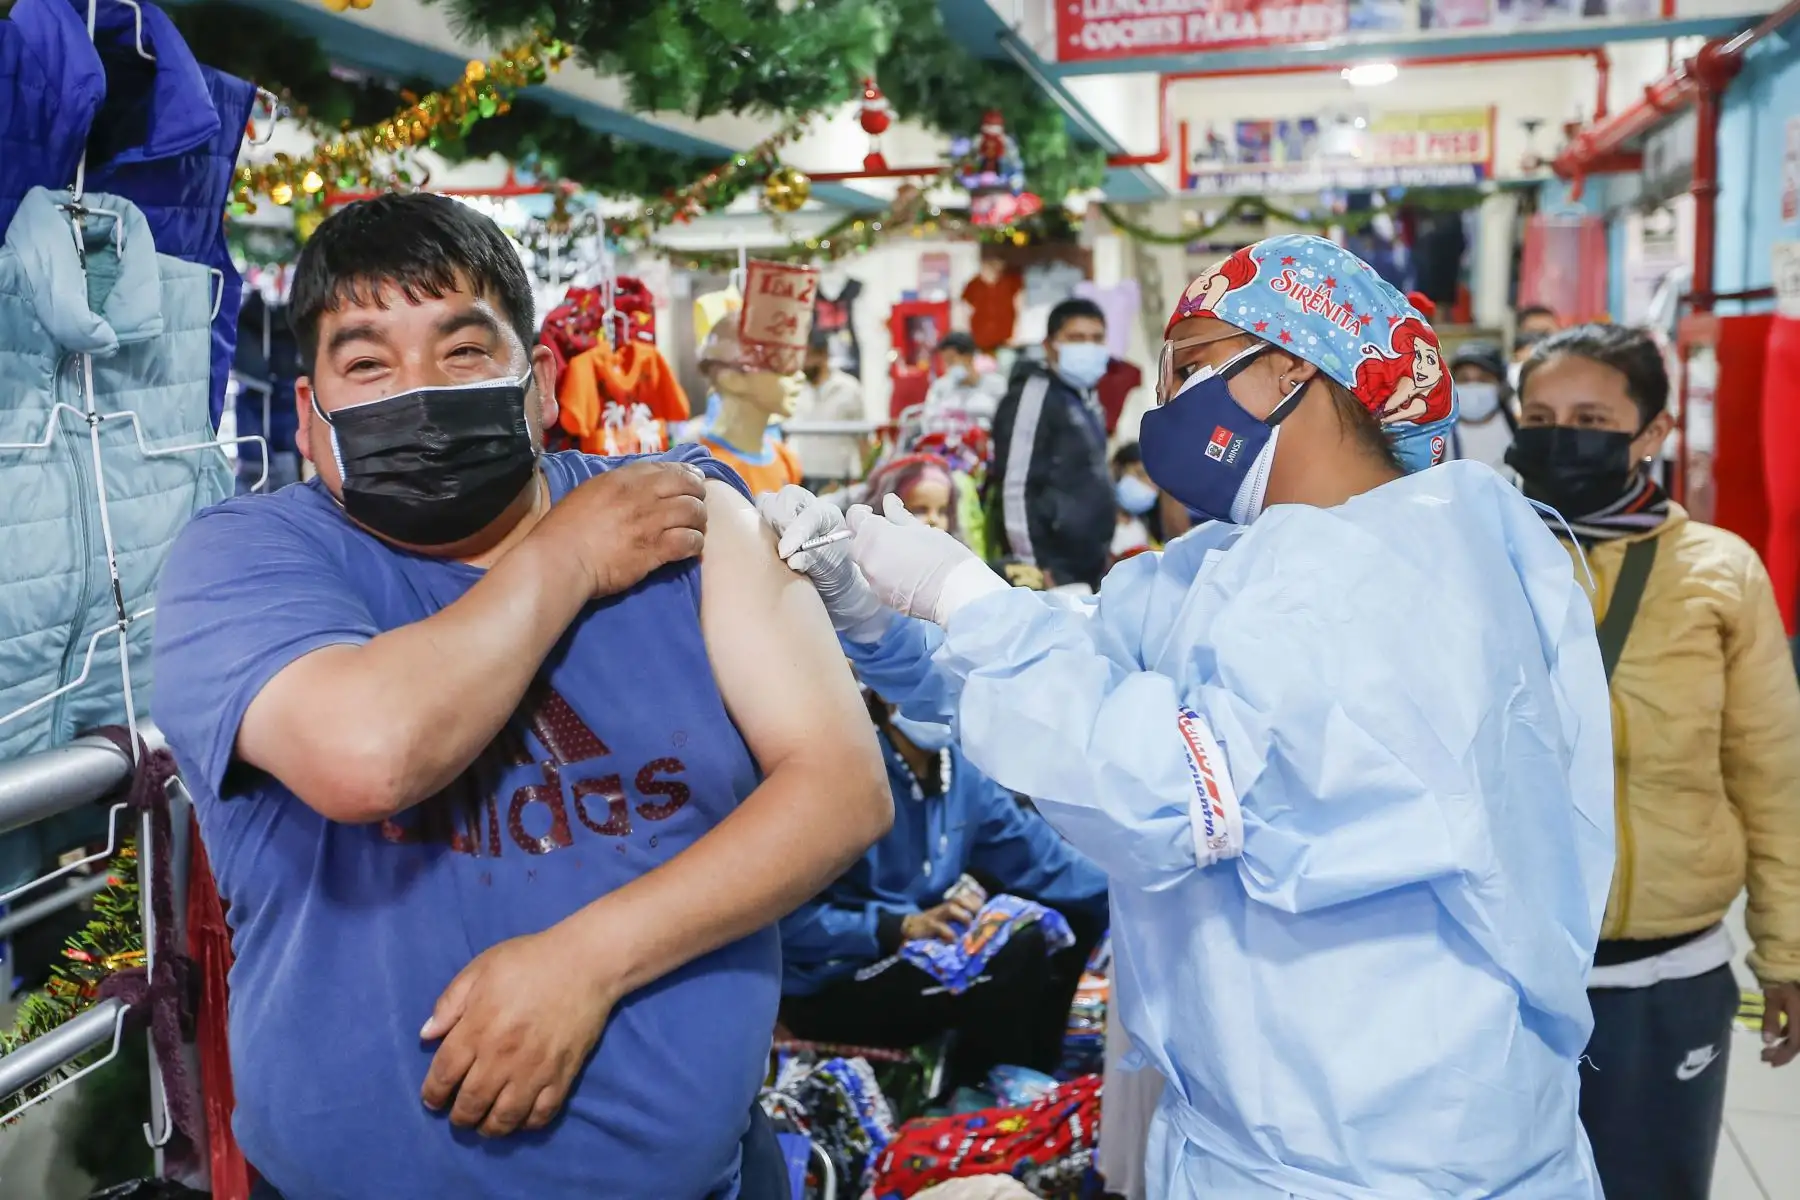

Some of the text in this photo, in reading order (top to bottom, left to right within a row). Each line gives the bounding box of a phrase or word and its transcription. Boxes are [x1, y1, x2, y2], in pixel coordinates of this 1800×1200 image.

[1269, 269, 1362, 338] SIRENITA
[1315, 283, 1332, 299] LA
[1226, 439, 1244, 465] MINSA
